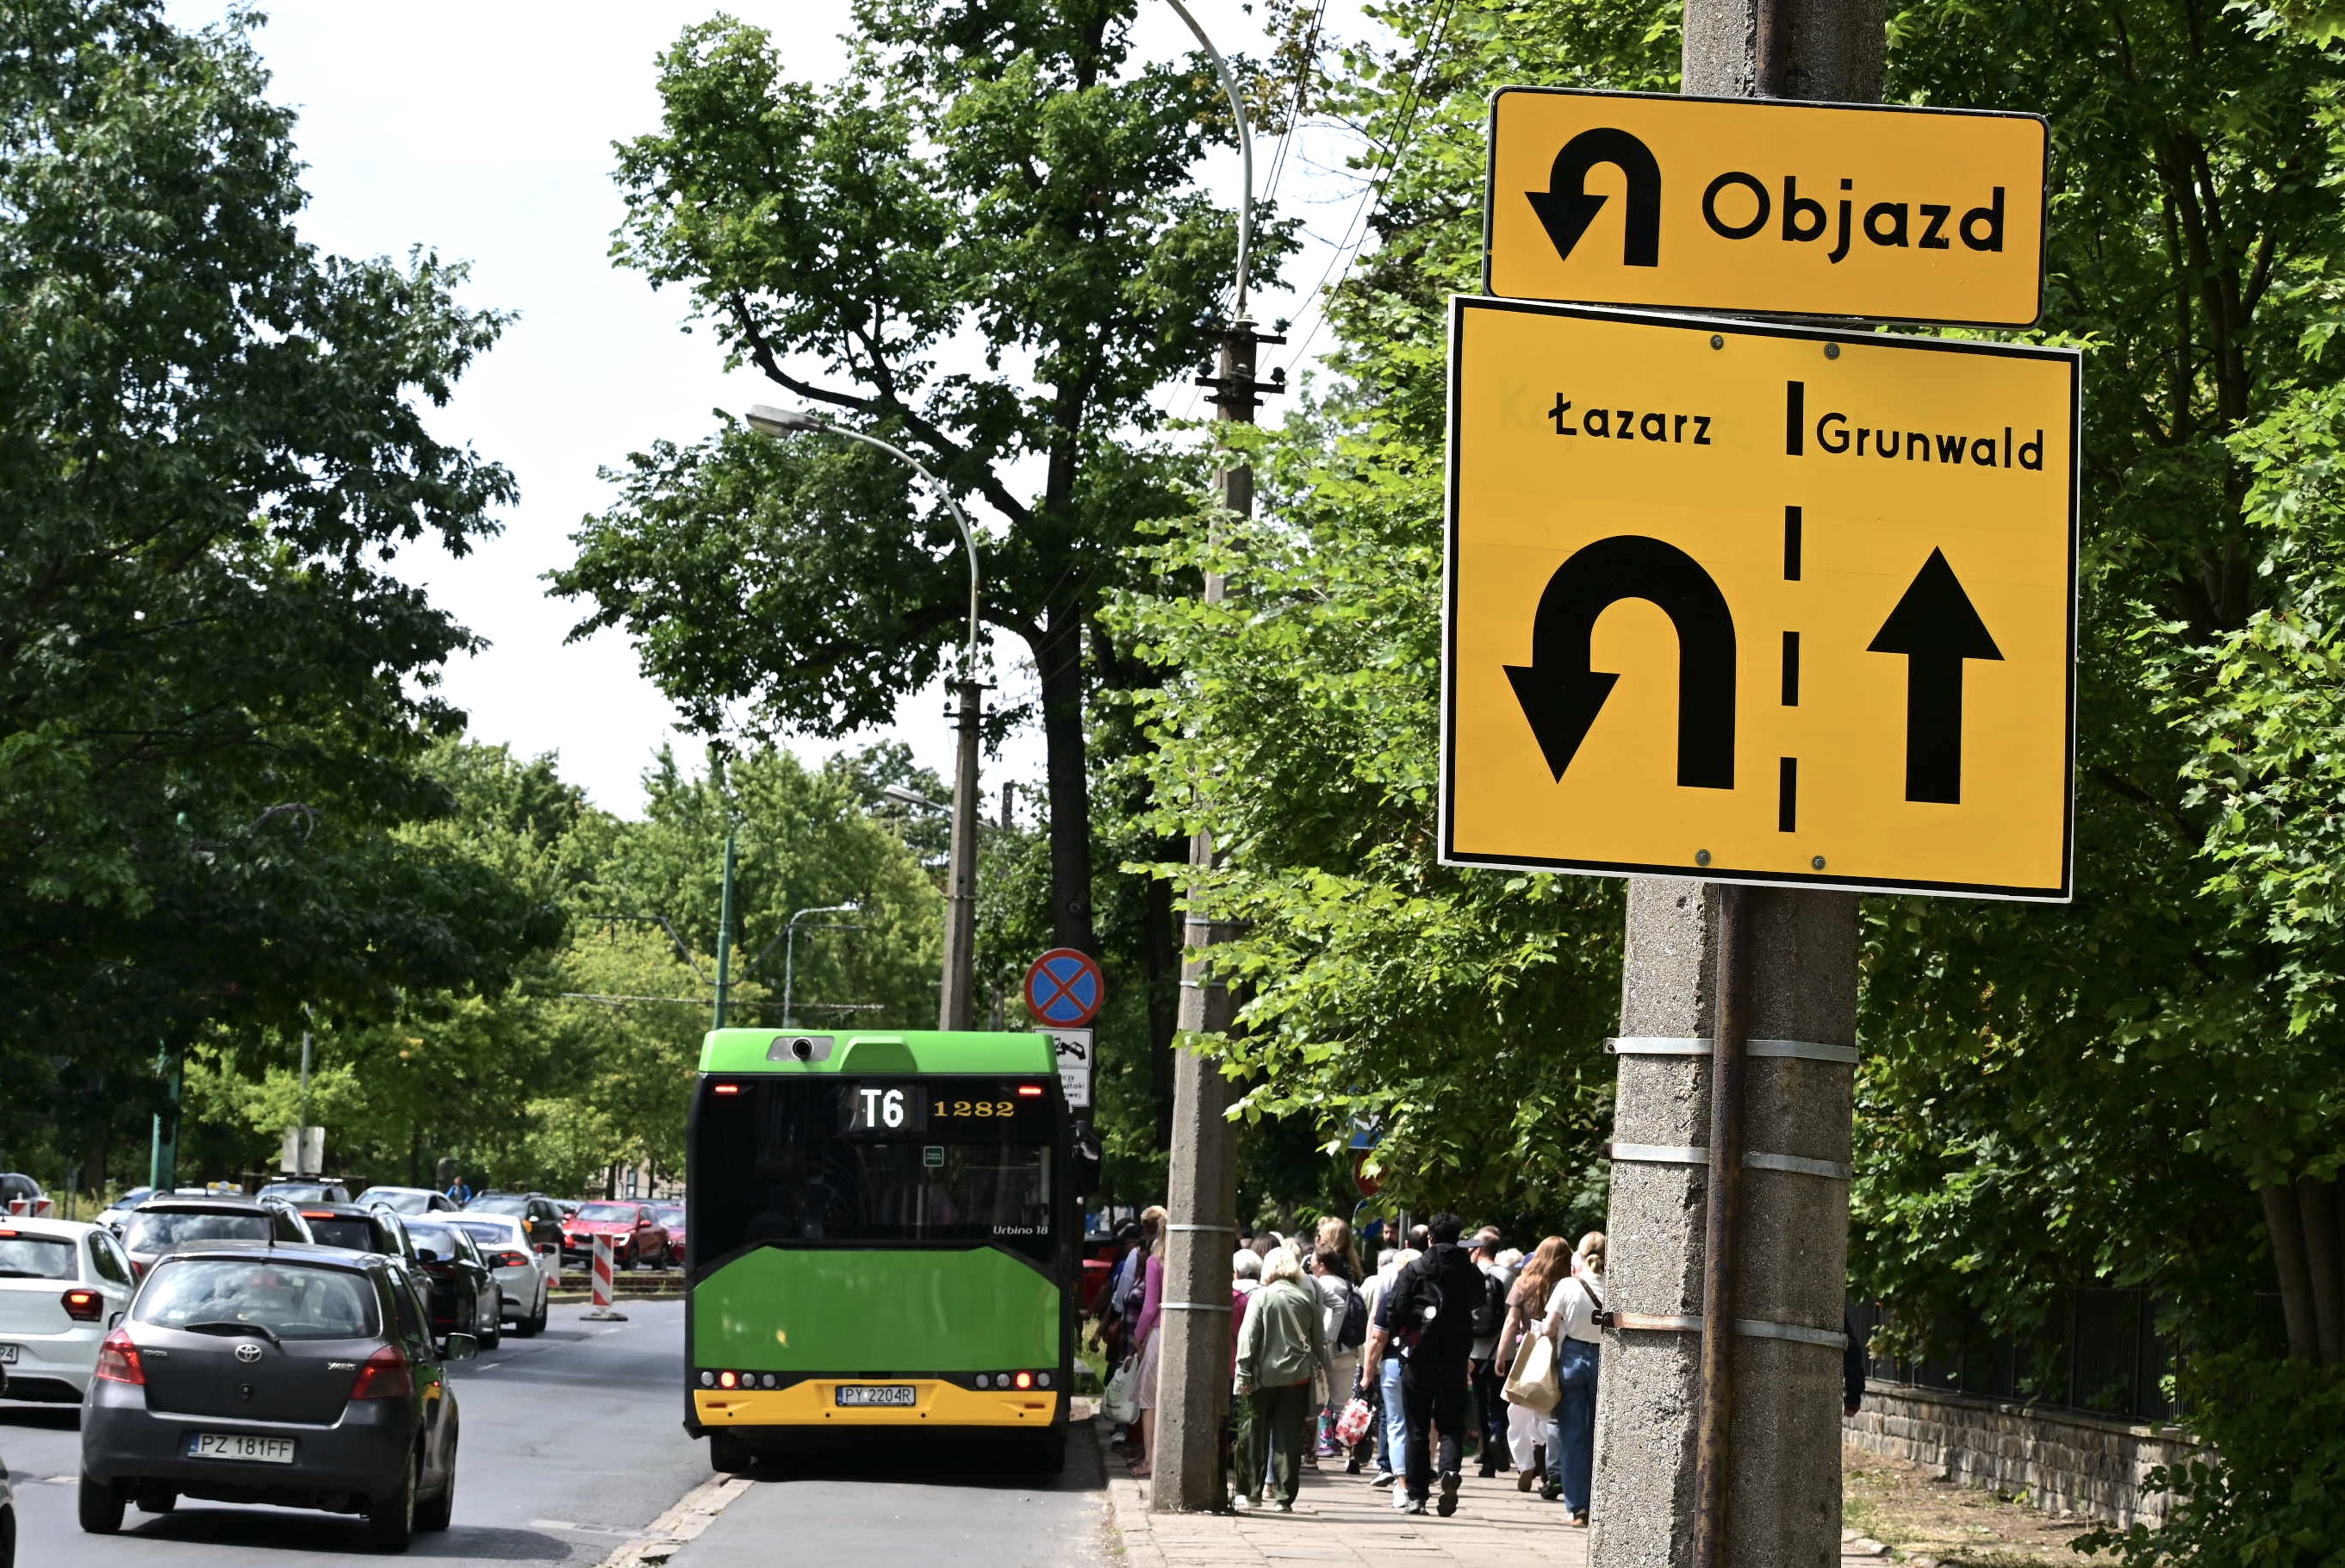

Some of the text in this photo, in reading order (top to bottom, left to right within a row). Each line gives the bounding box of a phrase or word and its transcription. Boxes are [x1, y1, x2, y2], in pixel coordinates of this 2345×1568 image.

[1702, 171, 2006, 264] Objazd
[1548, 392, 1712, 445] Łazarz
[1816, 412, 2043, 471] Grunwald
[860, 1089, 904, 1128] T6
[934, 1101, 1014, 1117] 1282
[993, 1225, 1048, 1235] Urbino 18
[845, 1388, 911, 1402] PY 2204R
[202, 1435, 291, 1458] PZ 181FF
